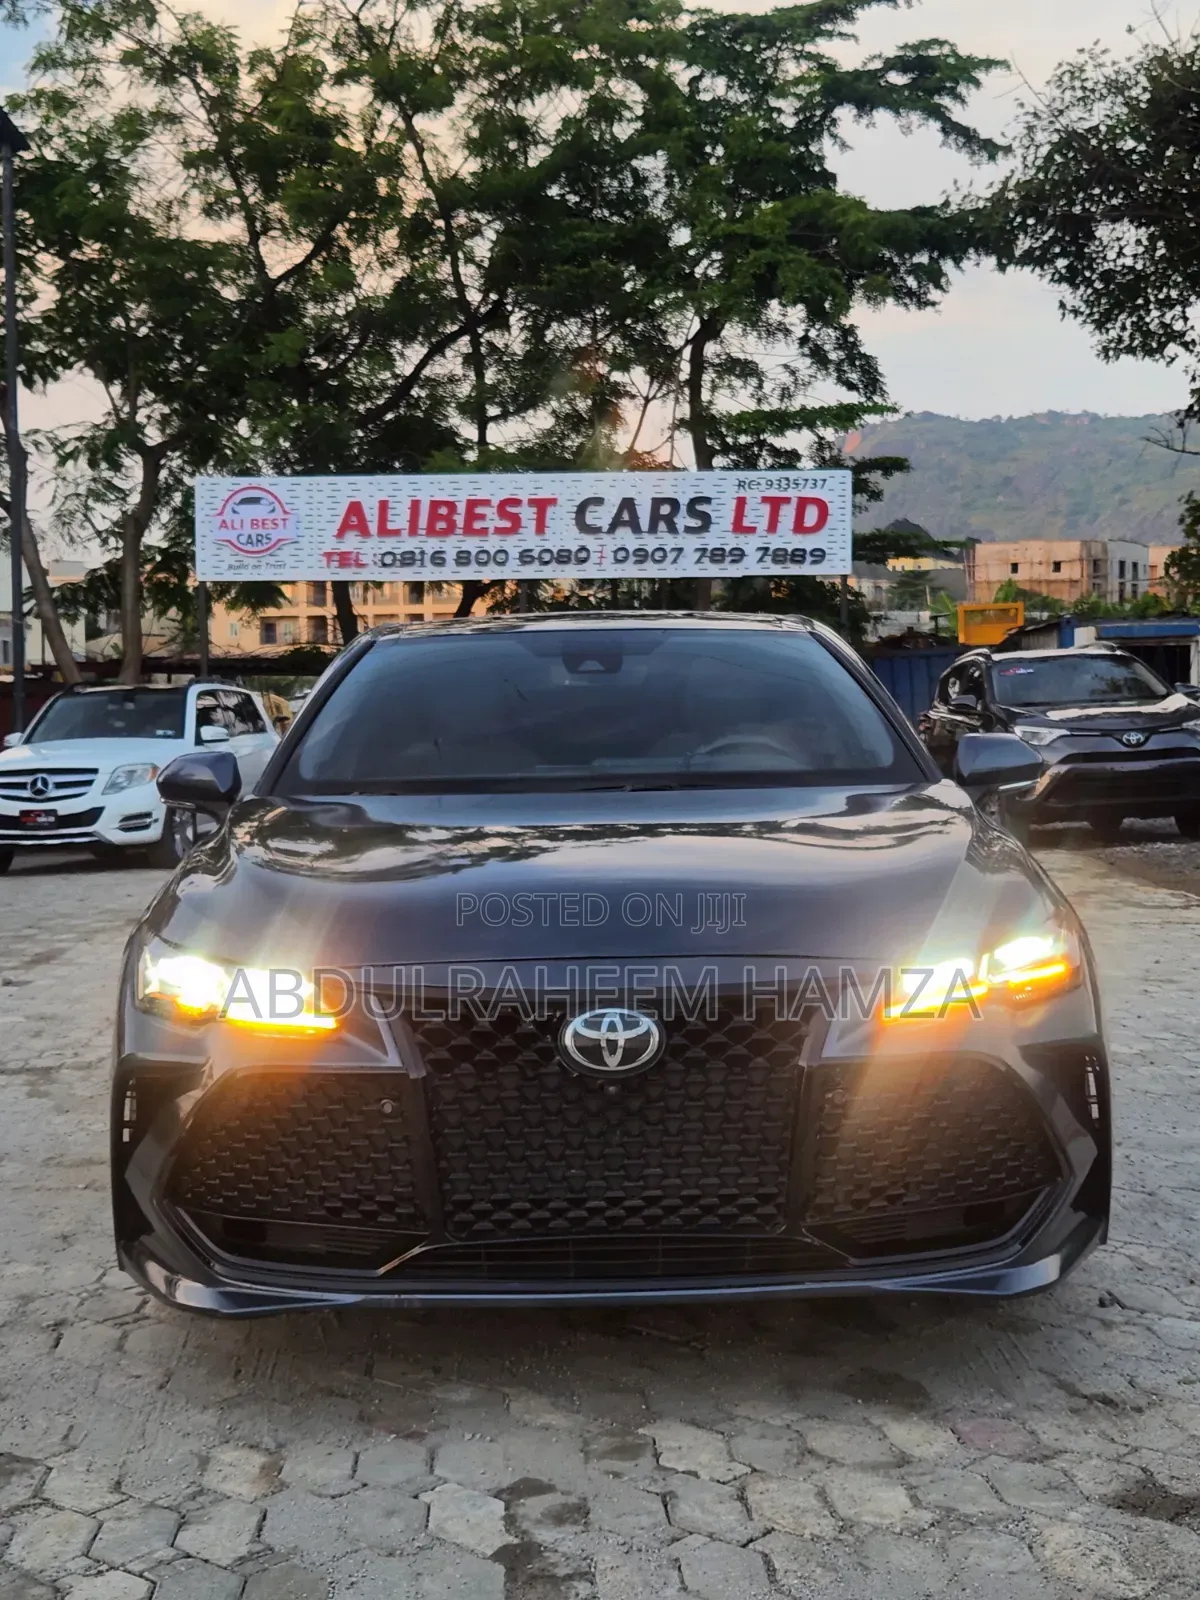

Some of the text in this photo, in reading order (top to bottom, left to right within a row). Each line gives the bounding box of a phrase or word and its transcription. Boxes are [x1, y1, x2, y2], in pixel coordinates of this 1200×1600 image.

[765, 477, 827, 490] 9335737
[218, 518, 289, 530] ALI BEST
[335, 496, 829, 539] ALIBEST CARS LTD
[236, 533, 272, 547] CARS
[455, 549, 509, 567] 800
[518, 547, 591, 566] 6080
[613, 546, 684, 565] 0907
[693, 546, 746, 564] 789
[755, 546, 826, 565] 7889
